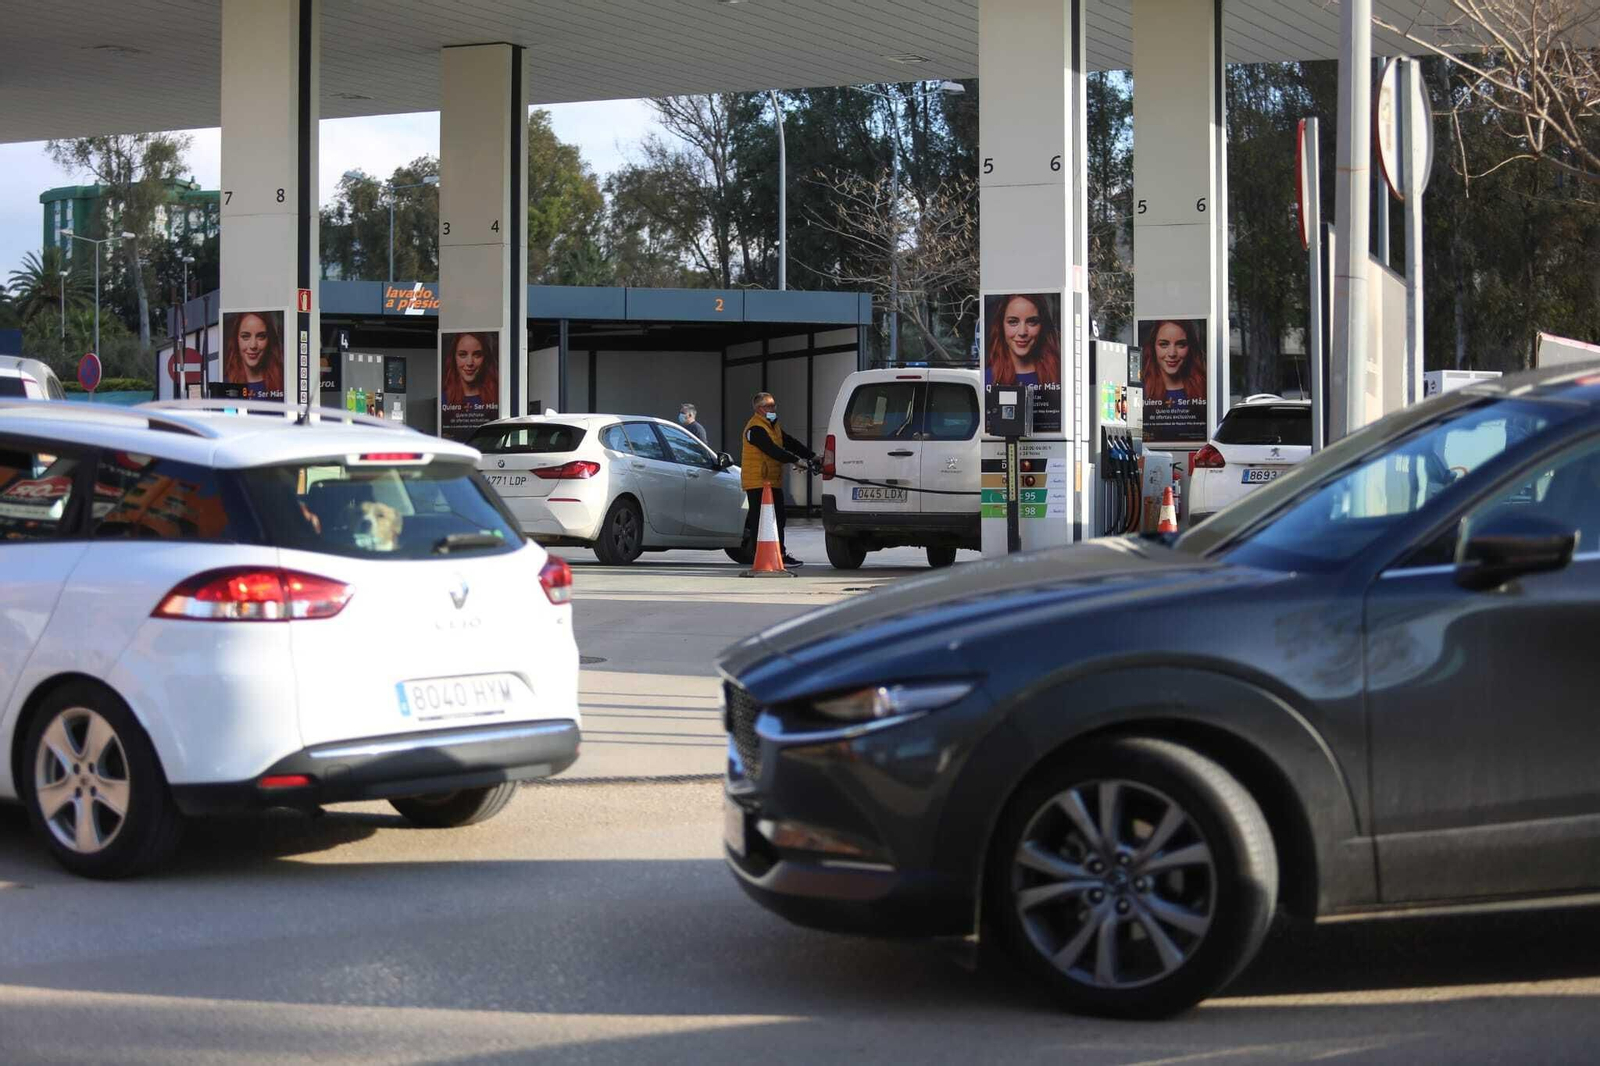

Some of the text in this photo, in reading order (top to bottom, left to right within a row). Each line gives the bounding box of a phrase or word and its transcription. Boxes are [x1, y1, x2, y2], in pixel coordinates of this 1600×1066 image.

[983, 155, 1061, 174] 5 6
[224, 188, 285, 206] 7 8
[1137, 197, 1206, 214] 5 6
[442, 220, 500, 235] 3 4
[385, 286, 433, 298] lavado
[385, 299, 395, 308] a
[715, 298, 724, 311] 2
[1091, 319, 1100, 338] 6
[341, 333, 349, 349] 4
[1044, 382, 1061, 391] Más
[257, 389, 284, 398] Ser Más
[1143, 397, 1207, 406] uiero Ser Más
[509, 476, 527, 486] LDP
[1249, 470, 1278, 481] 8693
[858, 488, 903, 499] 0445 LDX
[1024, 491, 1036, 501] 95
[1024, 506, 1036, 516] 98
[412, 682, 468, 710] 8040
